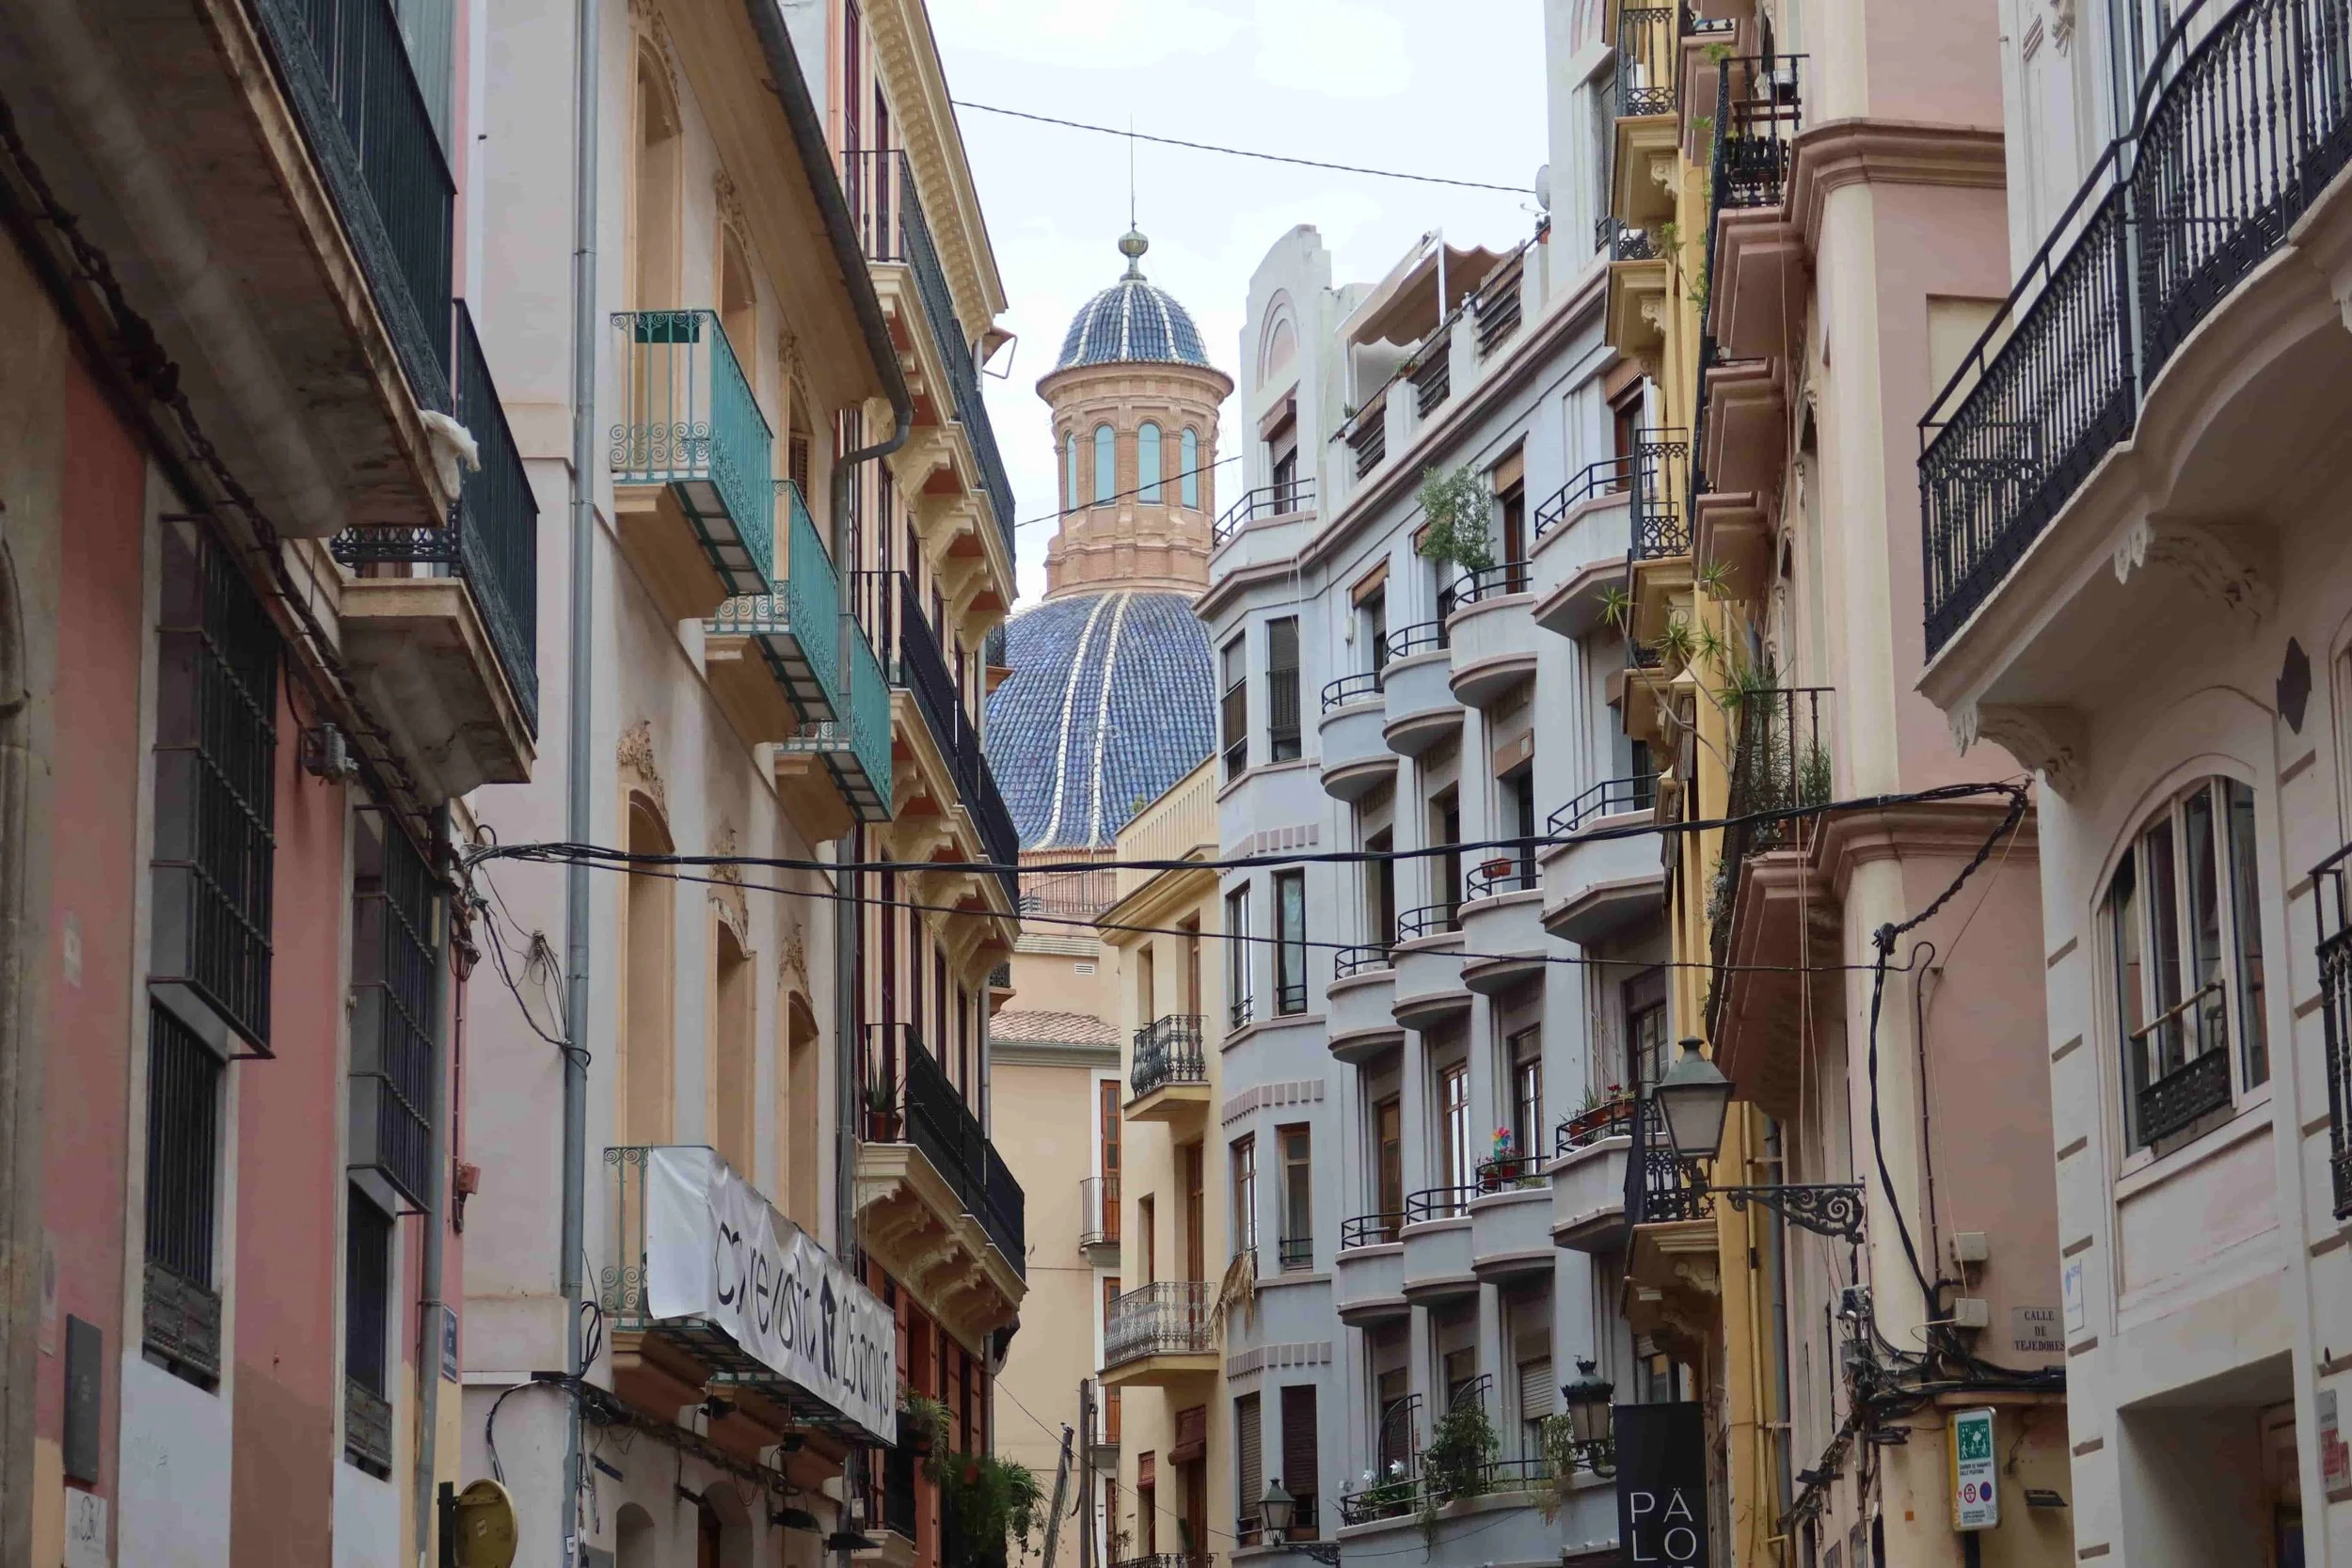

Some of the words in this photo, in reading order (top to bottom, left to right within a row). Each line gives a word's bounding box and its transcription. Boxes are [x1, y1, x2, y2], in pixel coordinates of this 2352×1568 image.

[2024, 1310, 2055, 1322] CALLE
[2034, 1325, 2047, 1337] DE
[2014, 1340, 2065, 1352] TEJEDORES
[860, 1334, 889, 1434] anys
